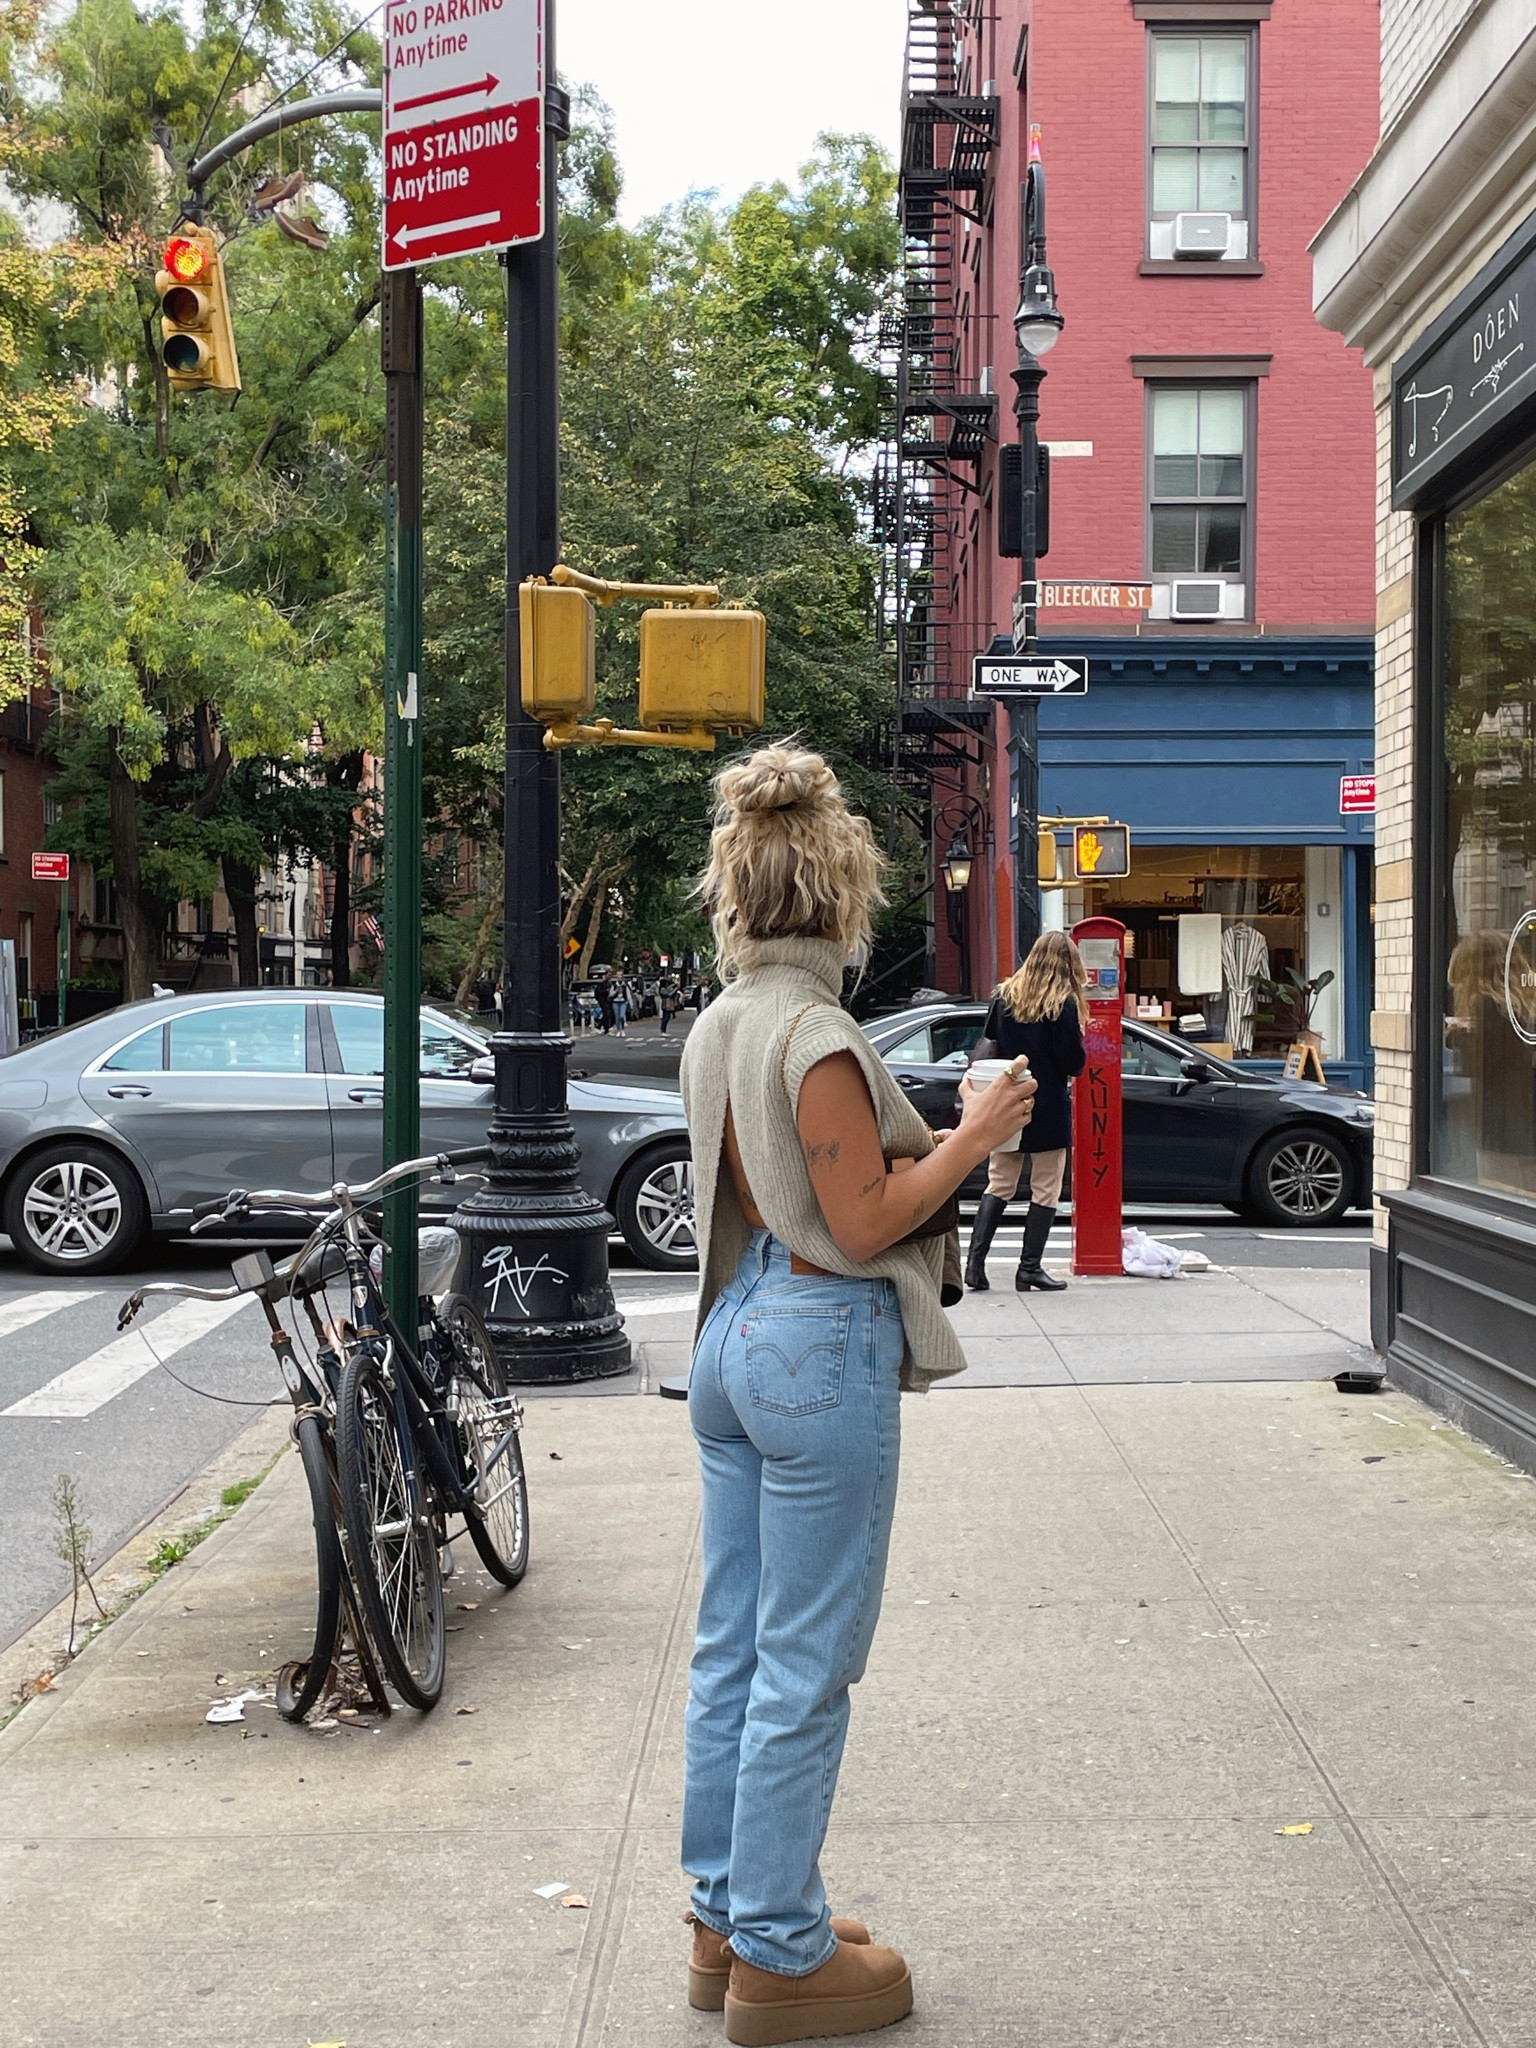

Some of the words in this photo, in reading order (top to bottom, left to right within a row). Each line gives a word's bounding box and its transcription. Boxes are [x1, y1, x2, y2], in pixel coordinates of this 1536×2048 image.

[393, 9, 418, 39] NO
[394, 33, 468, 69] Anytime
[391, 142, 418, 170] NO
[422, 116, 518, 163] STANDING
[392, 166, 470, 202] Anytime
[1045, 586, 1120, 607] BLEECKER
[1127, 587, 1145, 607] ST
[990, 669, 1022, 683] ONE
[1037, 669, 1069, 683] WAY
[1343, 780, 1354, 788] NO
